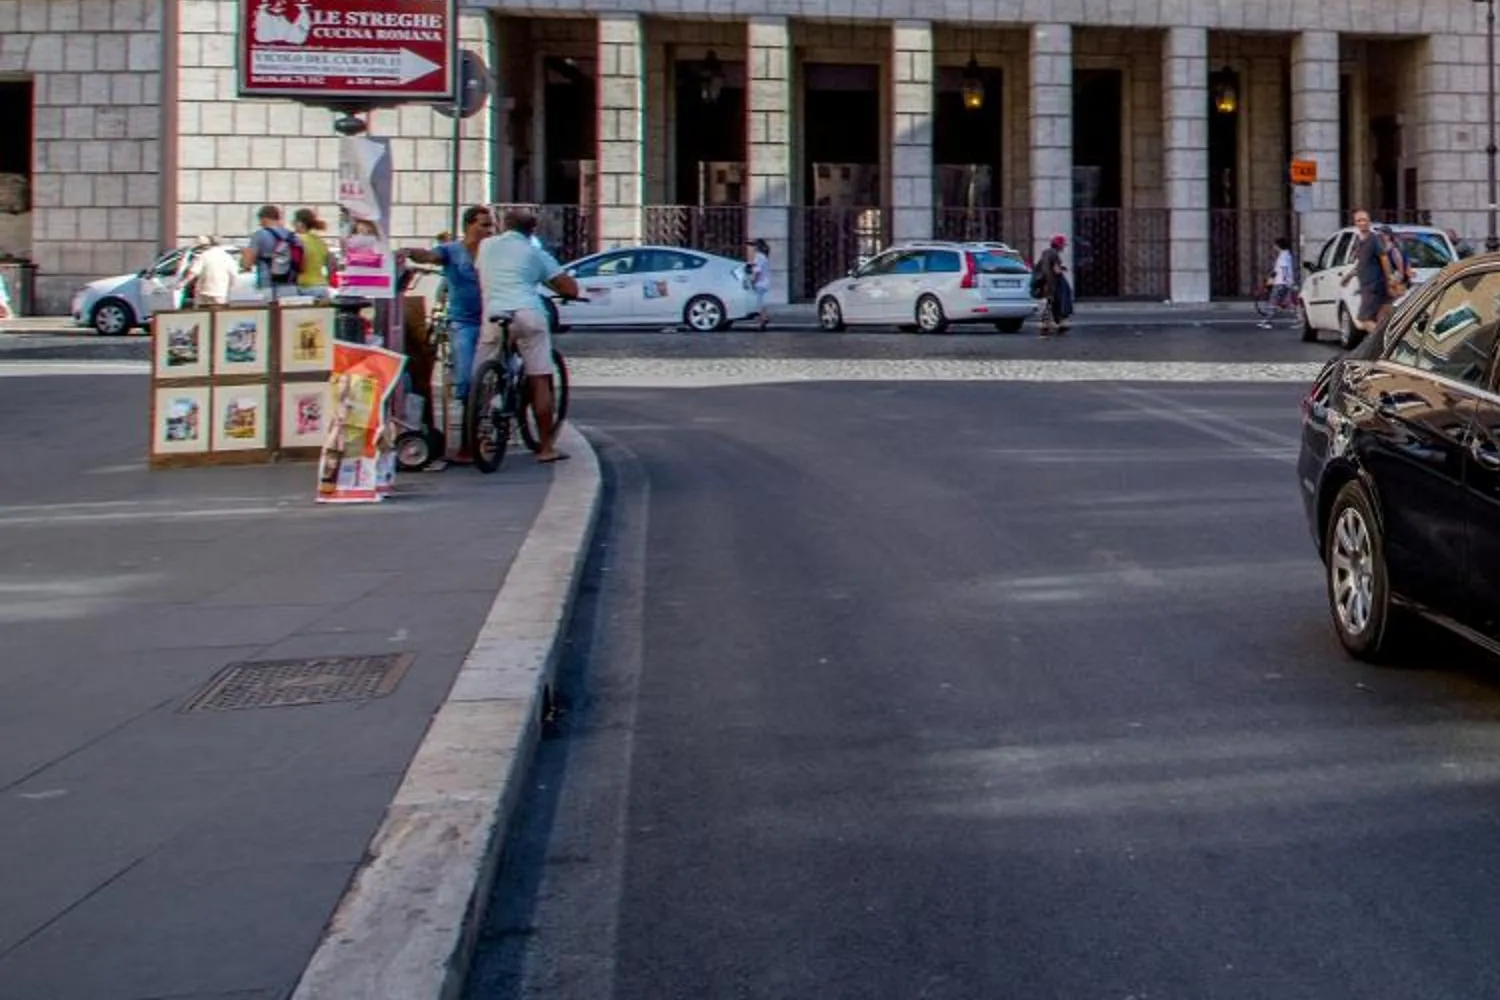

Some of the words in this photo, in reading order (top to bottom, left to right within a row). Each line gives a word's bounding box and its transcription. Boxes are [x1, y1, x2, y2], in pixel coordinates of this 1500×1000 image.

[311, 10, 341, 25] LE
[344, 12, 443, 29] STREGHE
[312, 27, 373, 39] CUCINA
[375, 29, 443, 41] ROMANA
